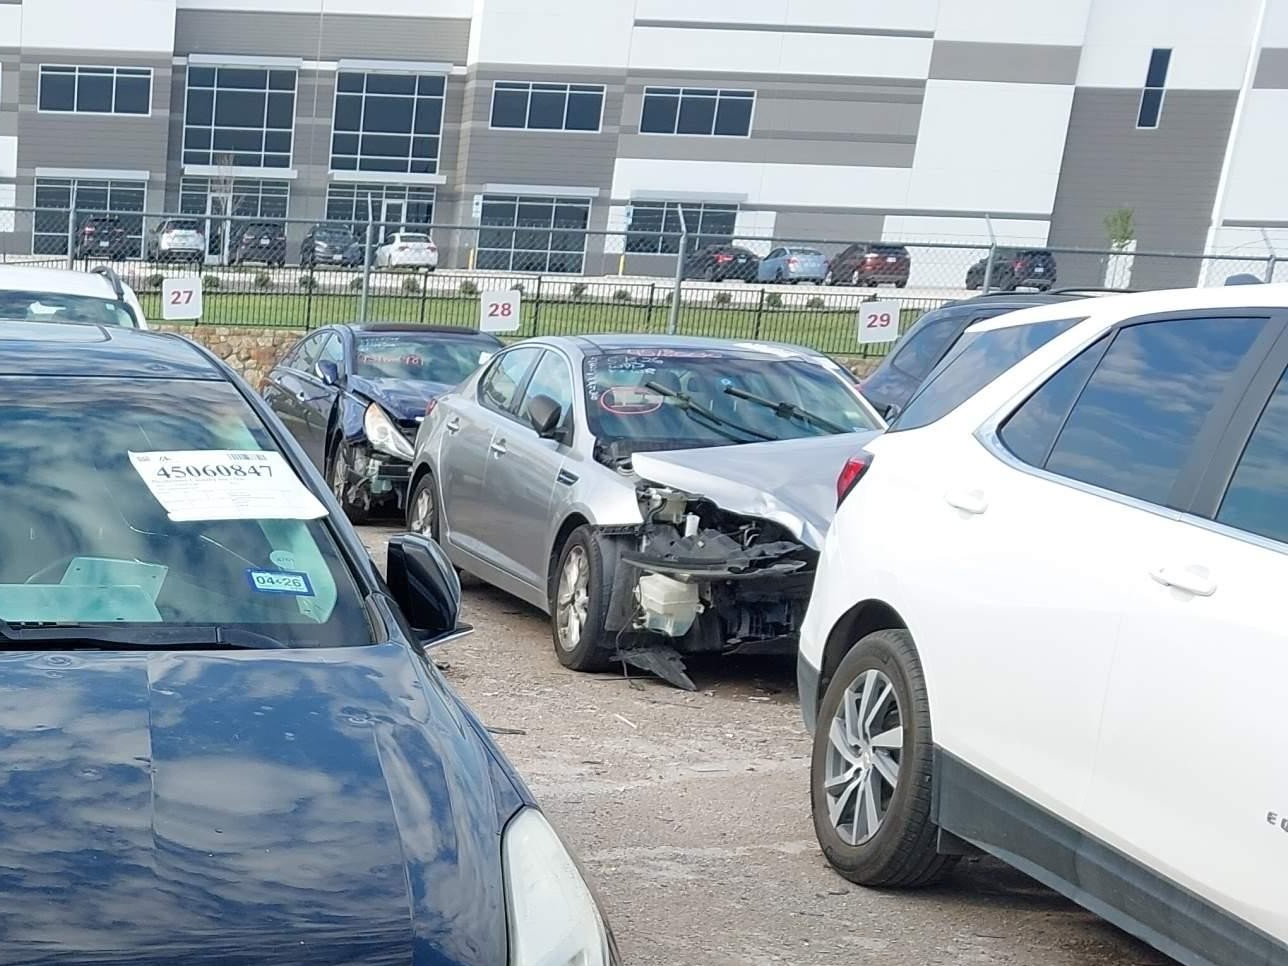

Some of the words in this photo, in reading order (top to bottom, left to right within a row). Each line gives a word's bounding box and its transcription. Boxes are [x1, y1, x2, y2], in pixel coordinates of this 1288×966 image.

[171, 290, 193, 305] 27
[488, 303, 512, 317] 28
[867, 313, 891, 328] 29
[156, 464, 273, 479] 45060847
